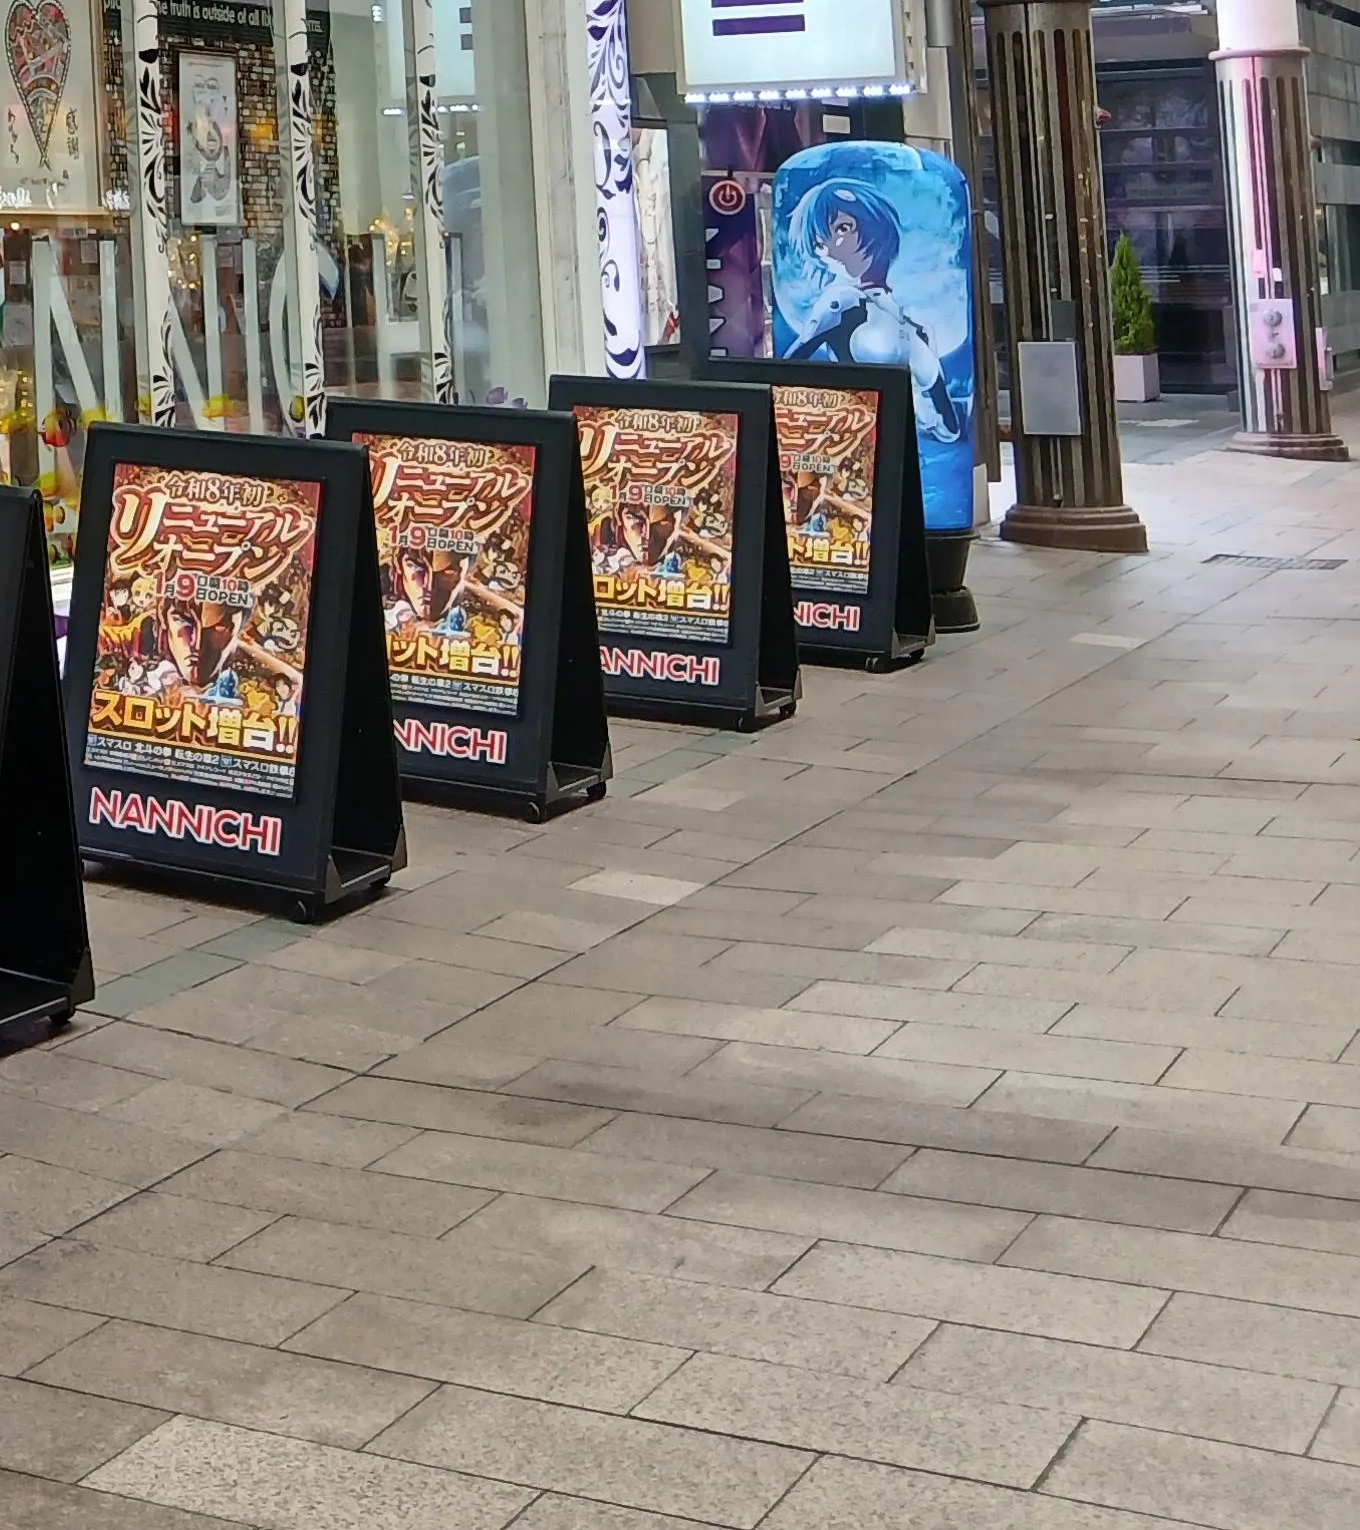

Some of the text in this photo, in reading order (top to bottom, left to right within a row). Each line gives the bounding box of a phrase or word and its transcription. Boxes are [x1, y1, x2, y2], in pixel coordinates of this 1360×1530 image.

[775, 389, 839, 409] 和8年初
[776, 409, 873, 432] ニューアル
[398, 441, 487, 468] 令和8年初
[777, 429, 854, 457] ープン
[165, 473, 265, 507] 令和8年初
[118, 492, 308, 565] リニューアル
[146, 534, 284, 579] オープン
[437, 539, 474, 553] OPEN
[788, 535, 870, 566] ト増台!!
[207, 589, 250, 606] OPEN
[593, 575, 730, 611] ロット増台!!
[793, 600, 861, 632] NICHI
[386, 635, 519, 678] ット増台!!
[599, 645, 720, 686] ANNICHI
[392, 718, 508, 764] NNICHI
[88, 785, 282, 856] NANNICHI
